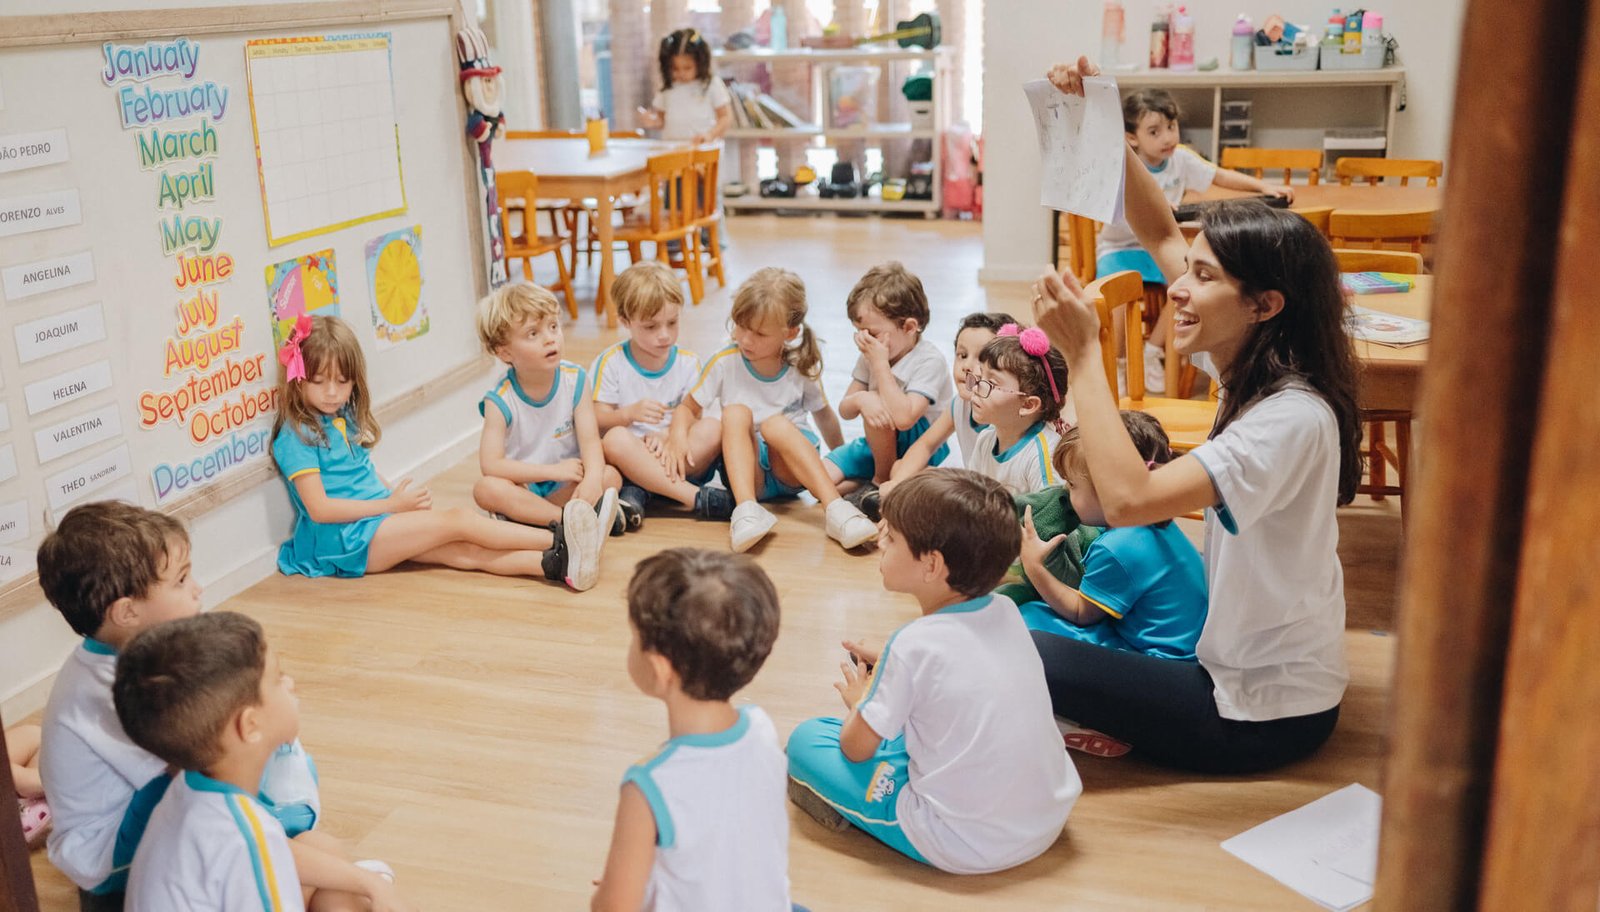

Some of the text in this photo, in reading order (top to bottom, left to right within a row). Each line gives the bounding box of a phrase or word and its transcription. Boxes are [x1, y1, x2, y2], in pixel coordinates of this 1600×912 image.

[105, 40, 199, 81] January
[121, 83, 228, 123] February
[0, 142, 51, 160] ÃO PEDRO
[139, 119, 217, 165] March
[159, 164, 214, 208] April
[0, 206, 65, 222] ORENZO ALVES
[163, 216, 220, 251] May
[23, 264, 71, 284] ANGELINA
[176, 255, 232, 287] June
[179, 290, 217, 334] July
[35, 321, 79, 343] JOAQUIM
[165, 319, 242, 374] August
[53, 381, 87, 400] HELENA
[140, 354, 264, 425] September
[53, 417, 102, 442] VALENTINA
[191, 388, 278, 442] October
[61, 464, 117, 494] THEO SANDRINI
[154, 430, 268, 499] December
[0, 521, 16, 531] ANTI
[0, 555, 11, 566] LA
